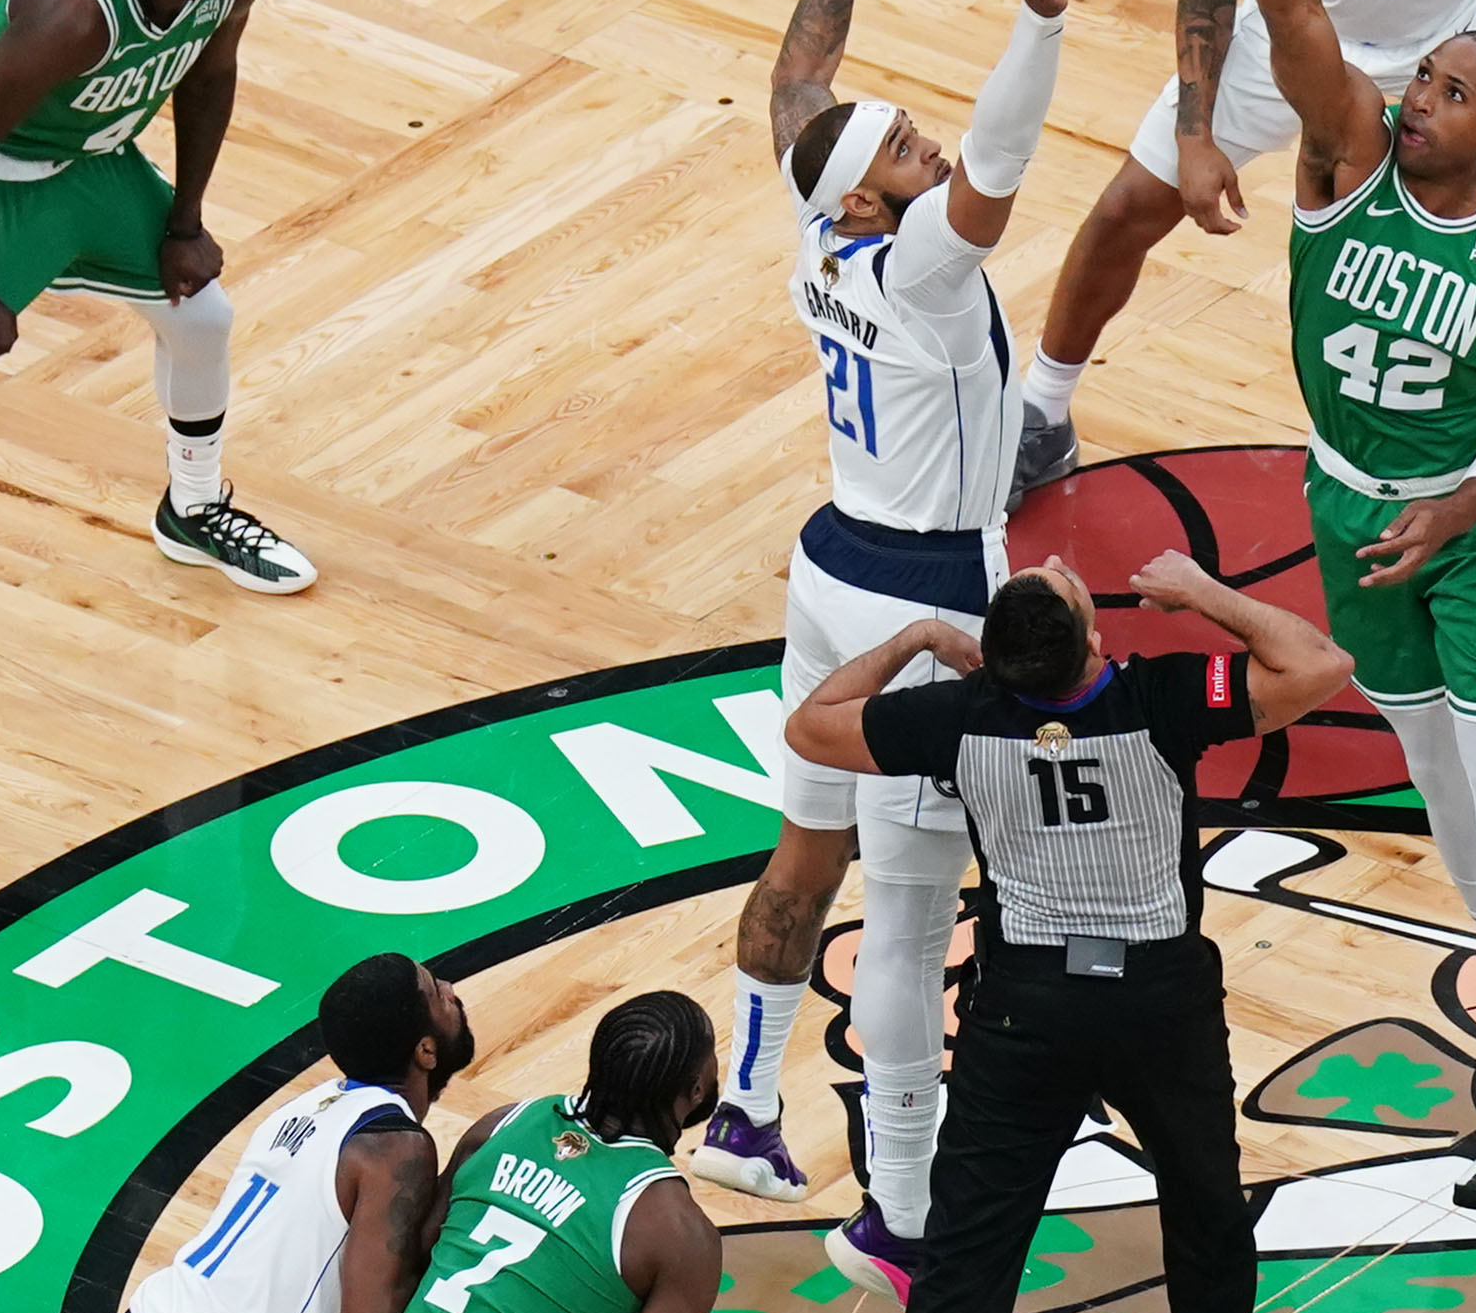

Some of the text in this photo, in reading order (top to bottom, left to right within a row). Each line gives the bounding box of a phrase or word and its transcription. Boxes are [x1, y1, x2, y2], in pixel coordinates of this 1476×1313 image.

[82, 107, 149, 157] 4
[819, 333, 879, 460] 21
[1323, 322, 1453, 411] 42
[1027, 756, 1111, 827] 15
[182, 1171, 281, 1280] 11
[489, 1152, 587, 1229] BROWN
